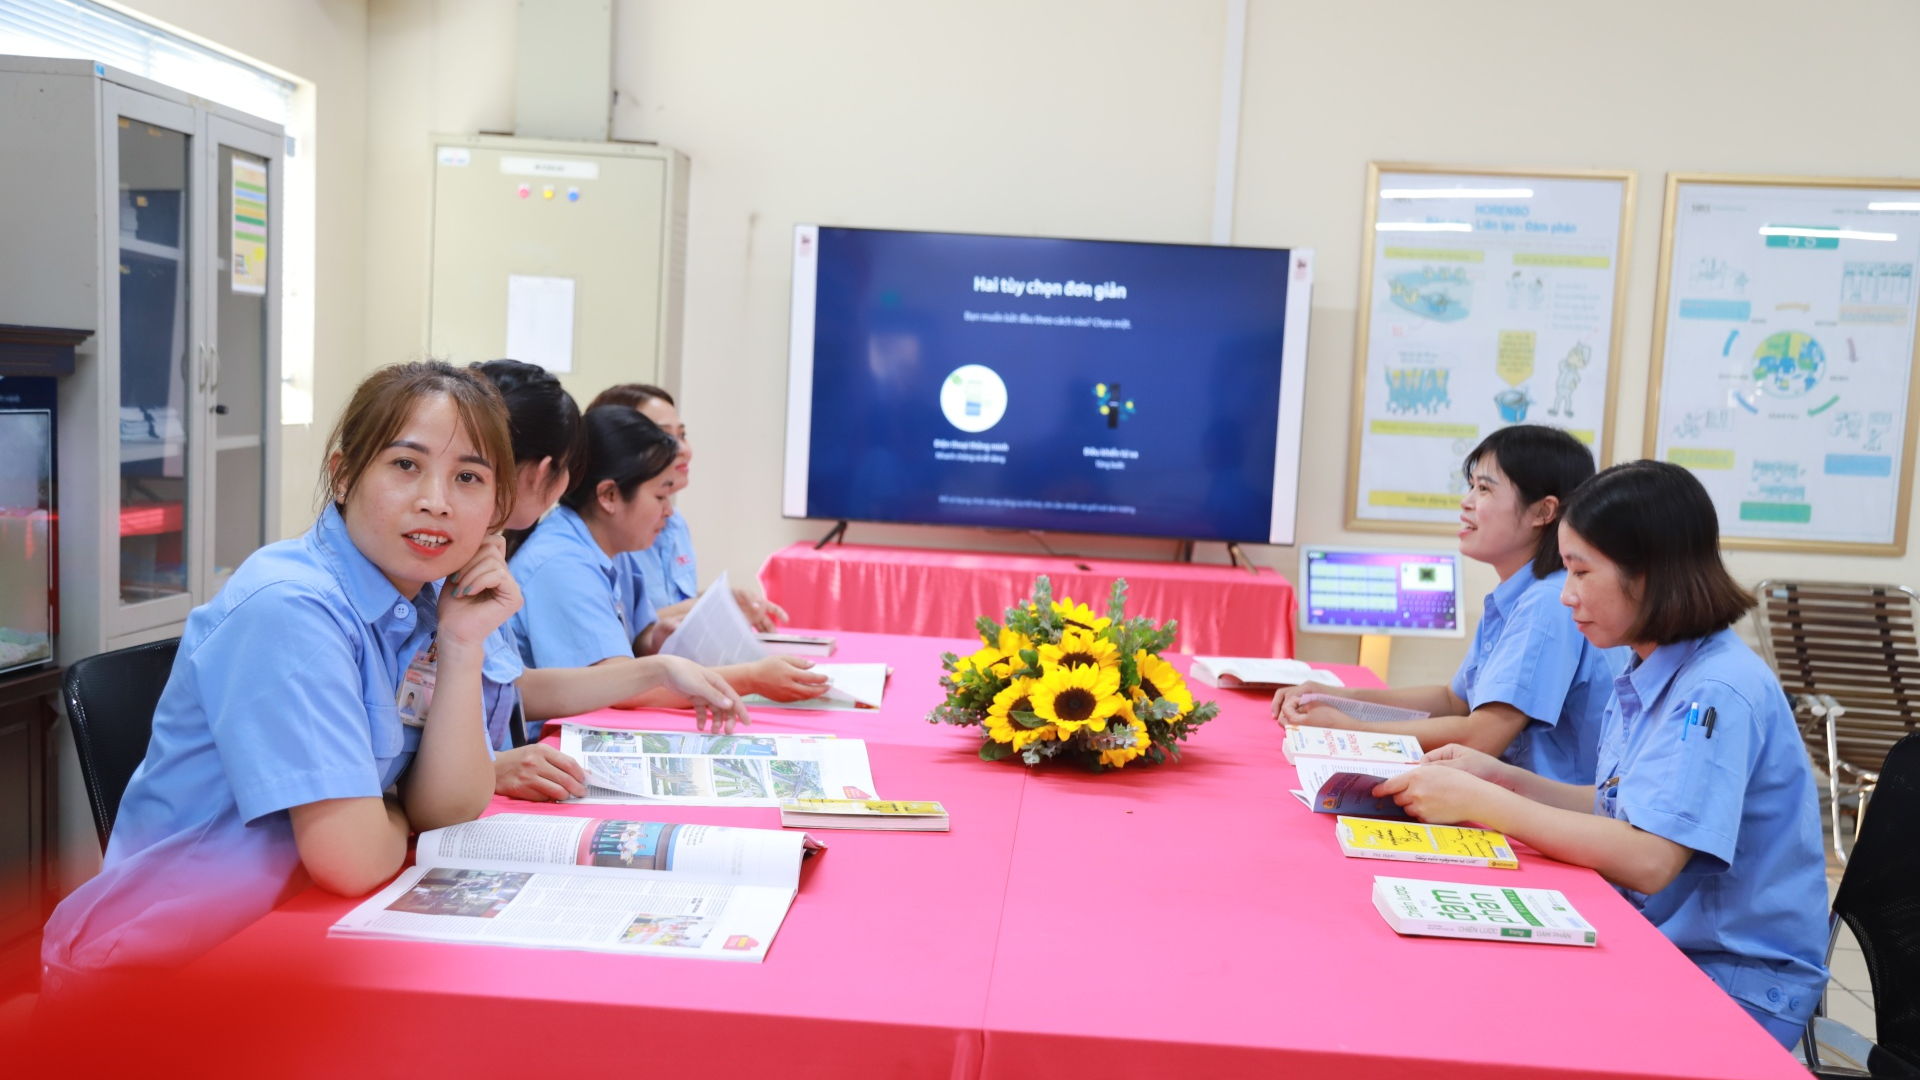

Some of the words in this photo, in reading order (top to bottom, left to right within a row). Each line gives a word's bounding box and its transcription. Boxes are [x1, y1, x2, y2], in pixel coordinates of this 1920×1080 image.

[1475, 205, 1529, 216] HORENSO
[973, 276, 998, 292] Hai
[1000, 277, 1026, 297] tùy
[1026, 278, 1063, 298] chọn
[1064, 280, 1093, 297] đơn
[1094, 281, 1127, 301] giản
[1431, 889, 1478, 921] đàm
[1470, 892, 1523, 924] phán
